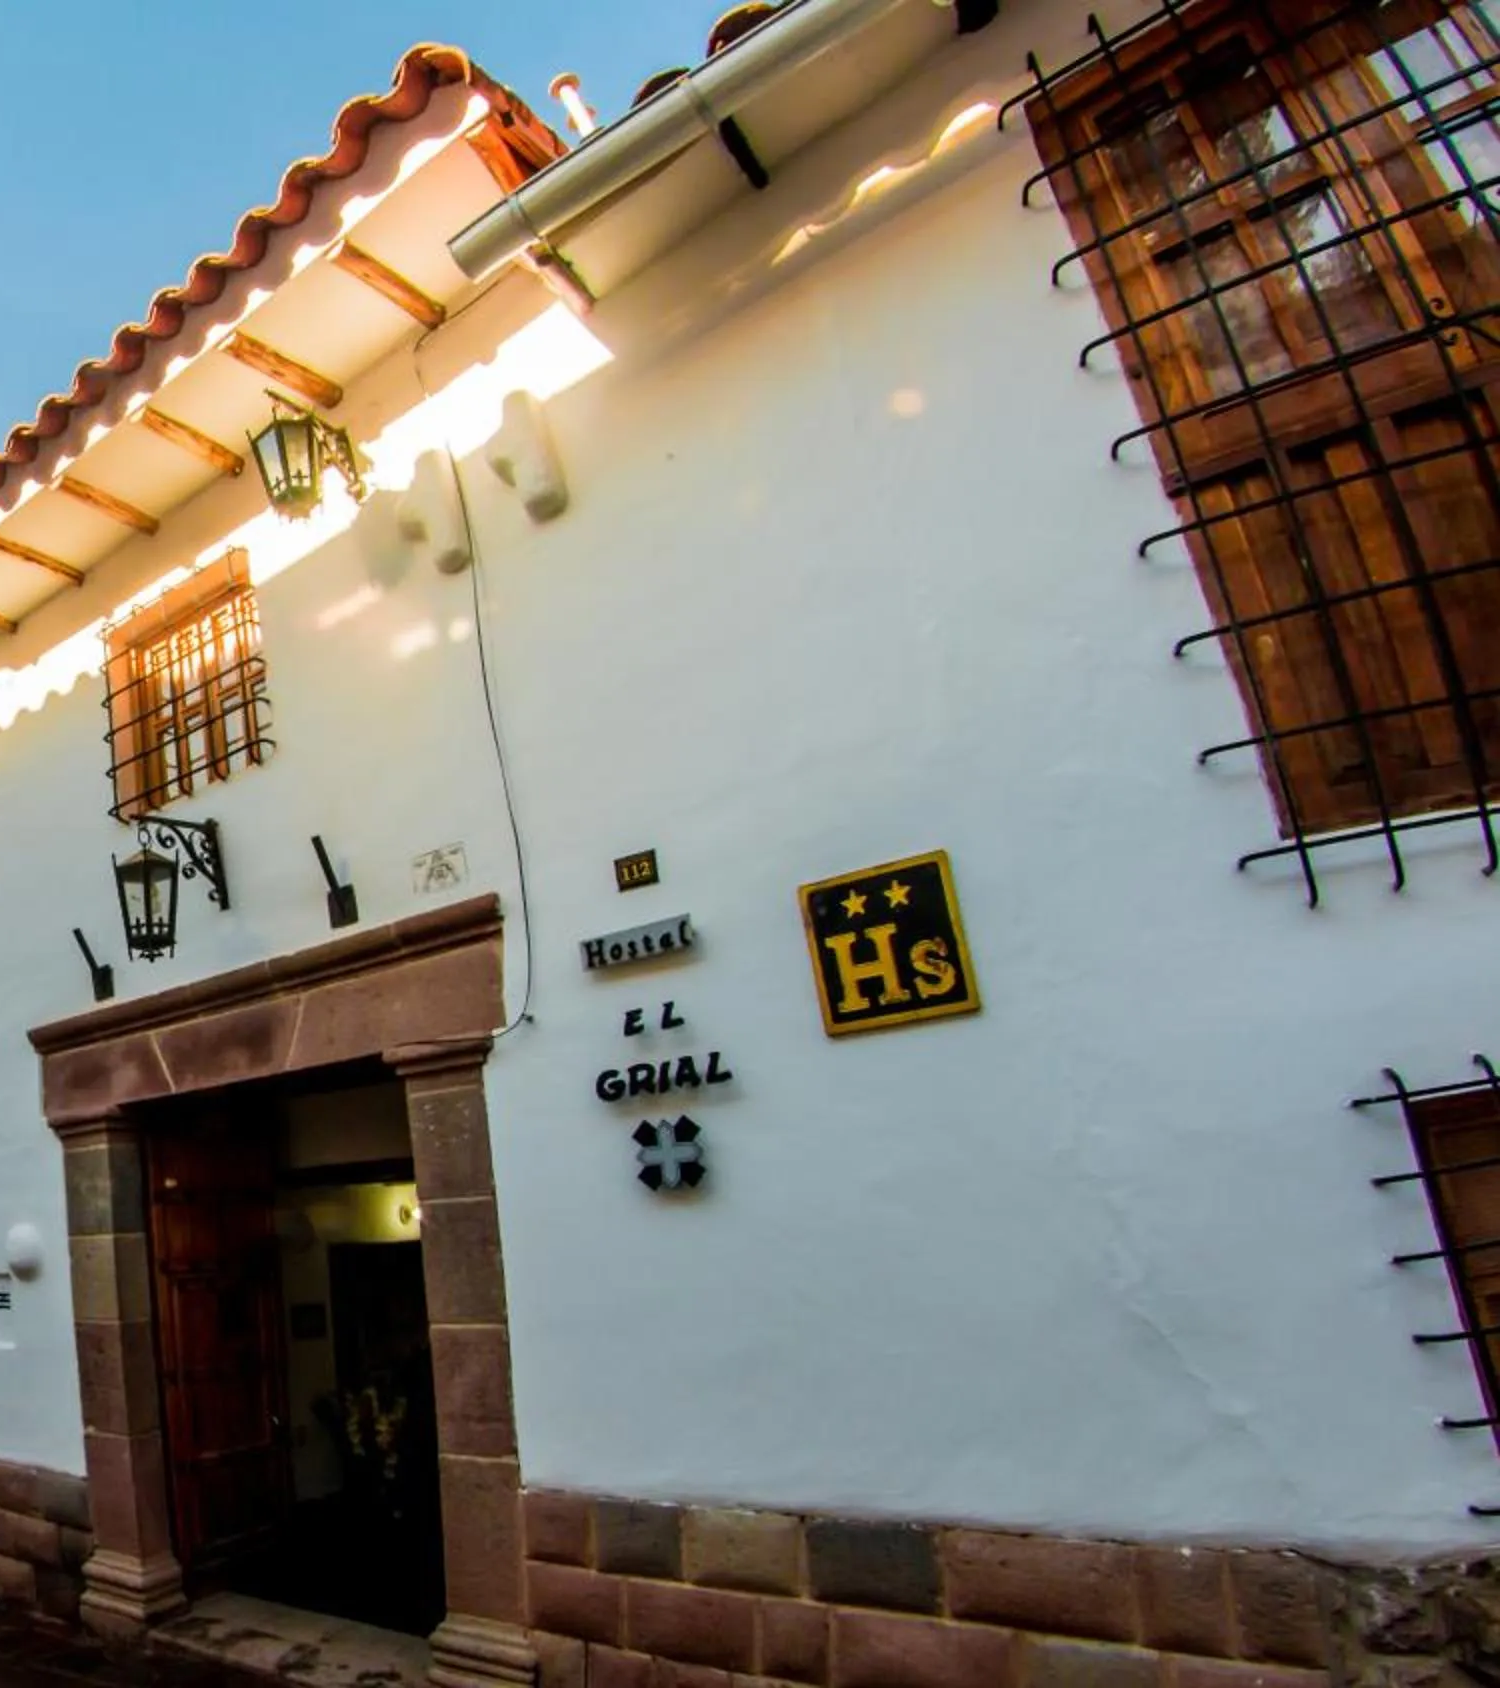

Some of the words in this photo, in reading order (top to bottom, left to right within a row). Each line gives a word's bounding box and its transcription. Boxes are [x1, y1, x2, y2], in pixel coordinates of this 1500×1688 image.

[621, 861, 652, 882] 112
[583, 919, 694, 969] Hostal
[824, 923, 956, 1013] Hs
[623, 1000, 685, 1037] EL
[596, 1051, 733, 1102] GRIAL
